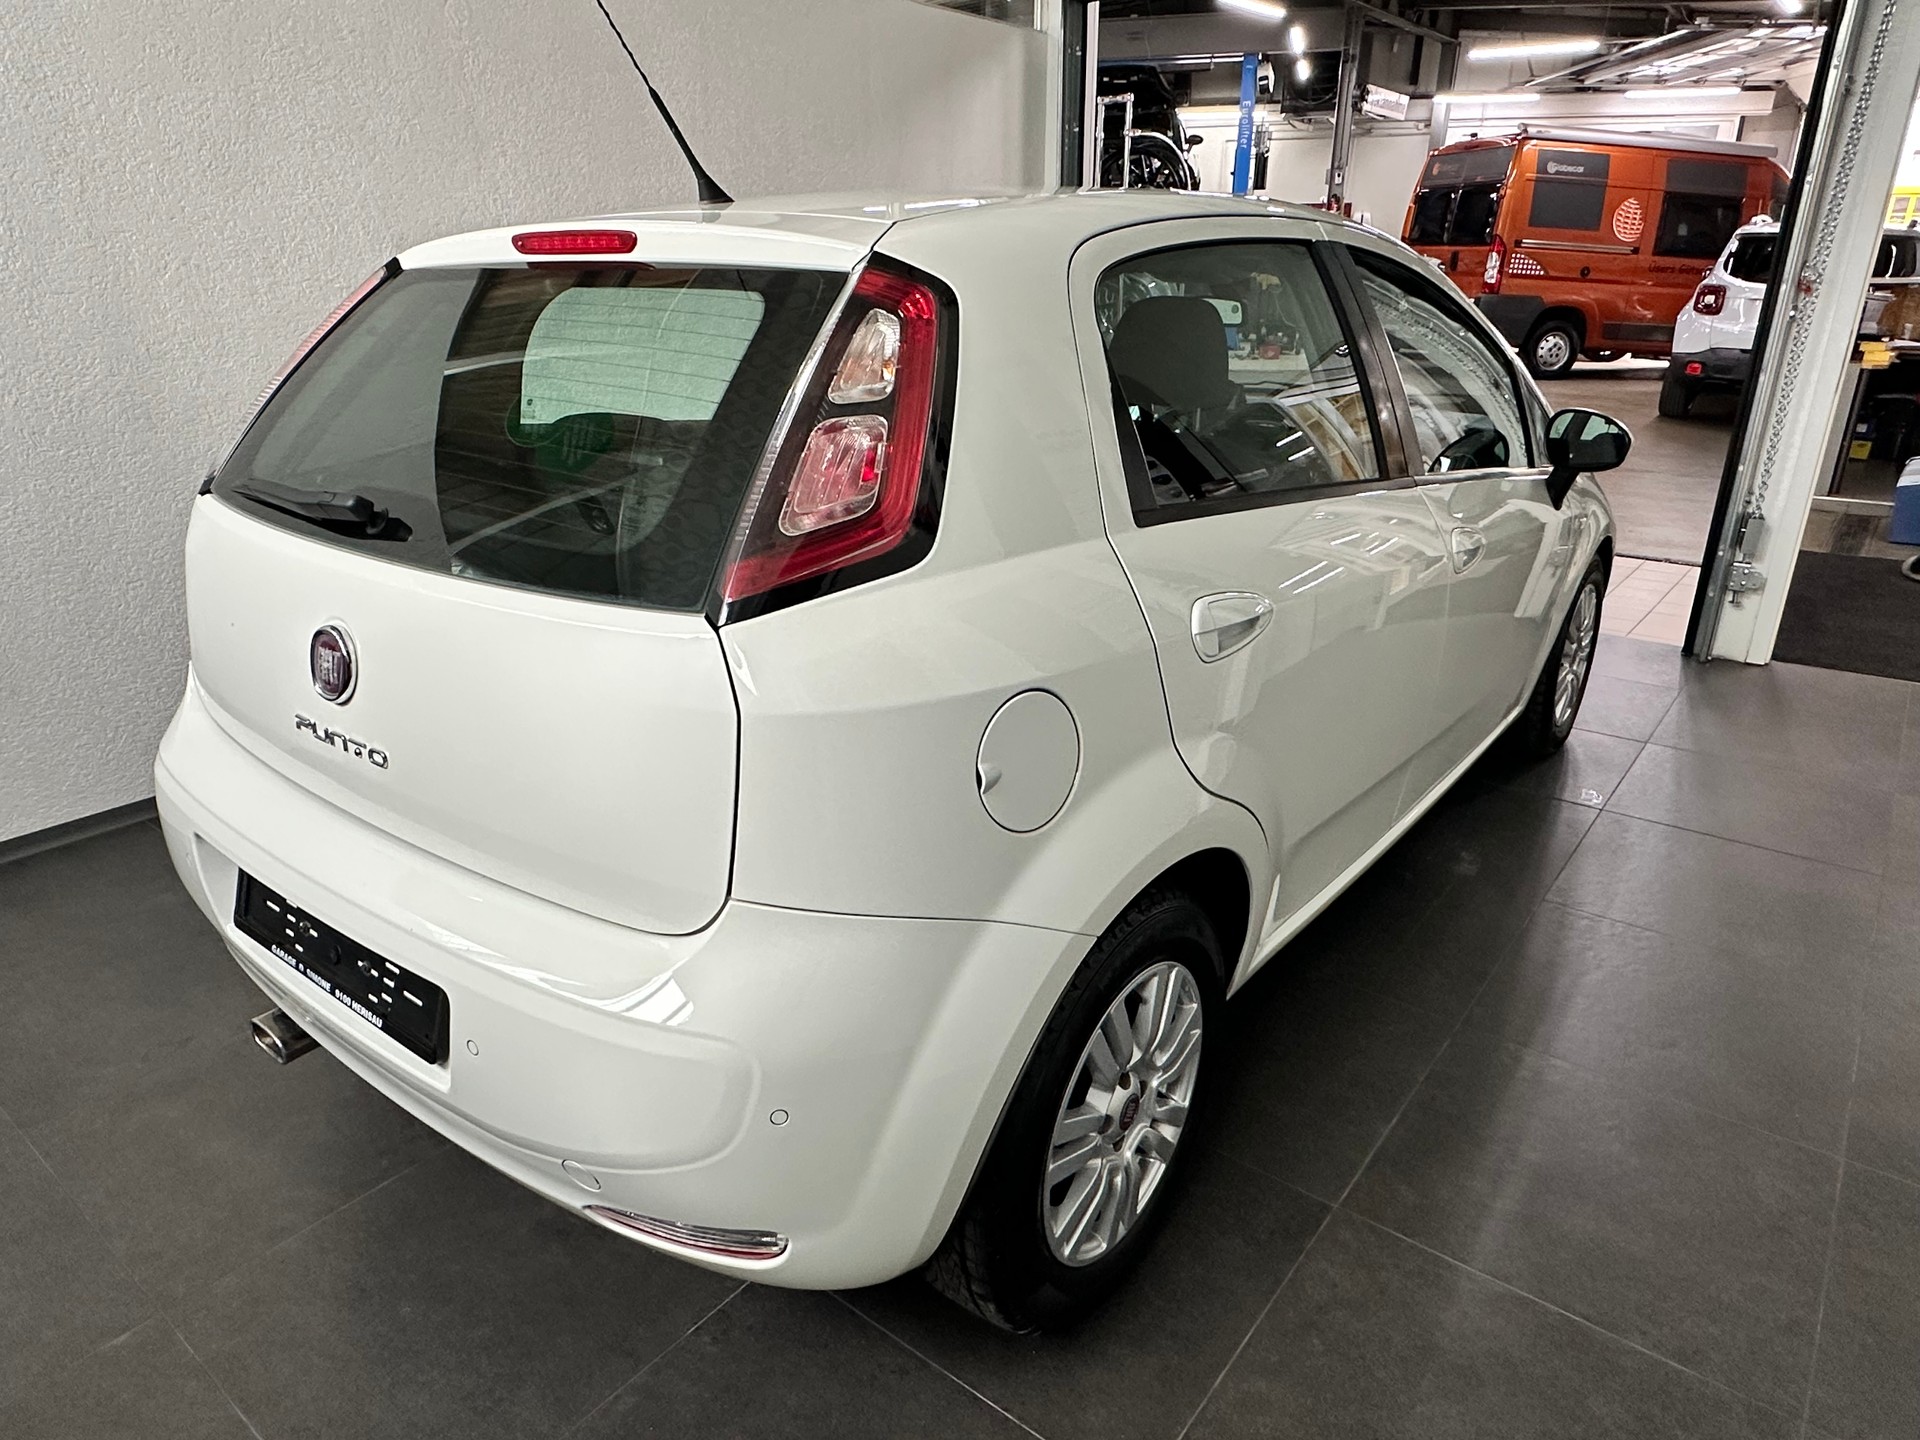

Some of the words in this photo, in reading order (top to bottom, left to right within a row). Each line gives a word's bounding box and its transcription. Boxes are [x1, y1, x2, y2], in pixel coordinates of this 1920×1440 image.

[1240, 100, 1252, 149] Eurolifter
[294, 713, 390, 770] PUNTO
[271, 944, 297, 968] GARAGE
[306, 968, 332, 992] SIMONE
[351, 1000, 383, 1028] HERISAU
